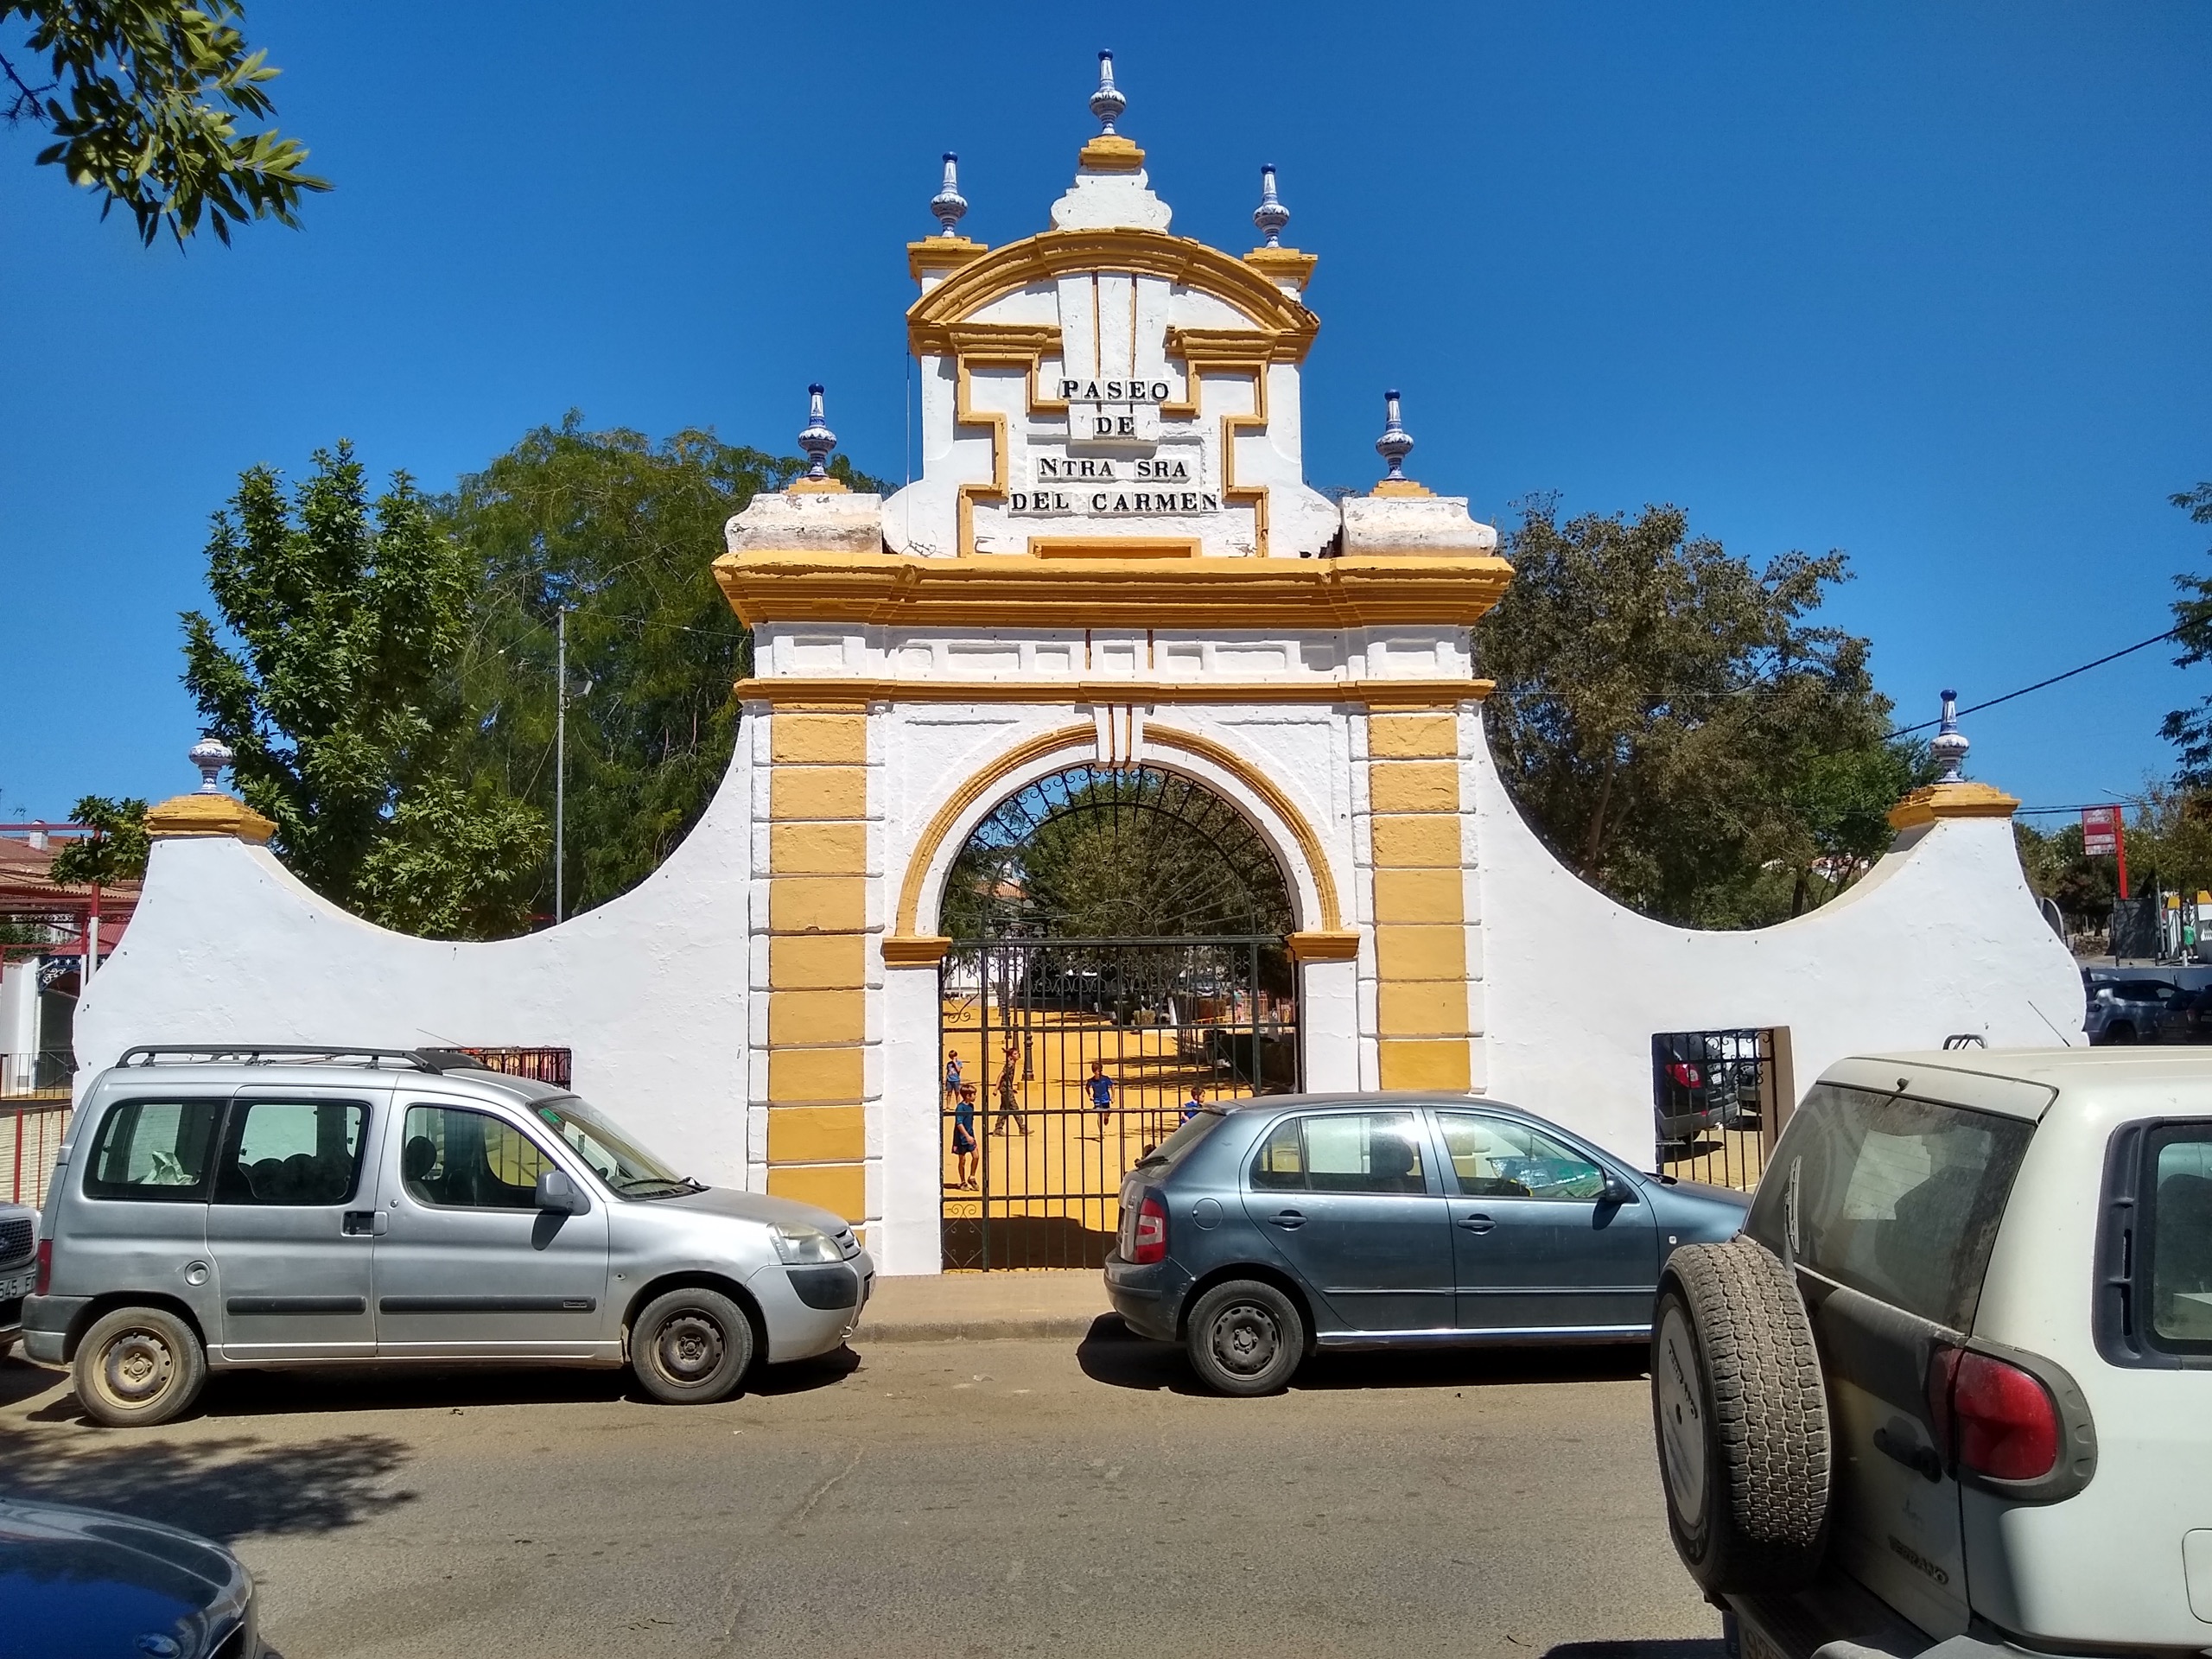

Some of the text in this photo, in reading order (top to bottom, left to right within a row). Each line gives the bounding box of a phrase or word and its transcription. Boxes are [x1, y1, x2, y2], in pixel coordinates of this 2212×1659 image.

[1062, 380, 1169, 400] PASEO
[1096, 416, 1135, 435] DE
[1039, 458, 1187, 478] NTRA SRA
[1011, 493, 1218, 512] DEL CARMEN
[1887, 1534, 1949, 1585] TERRANO
